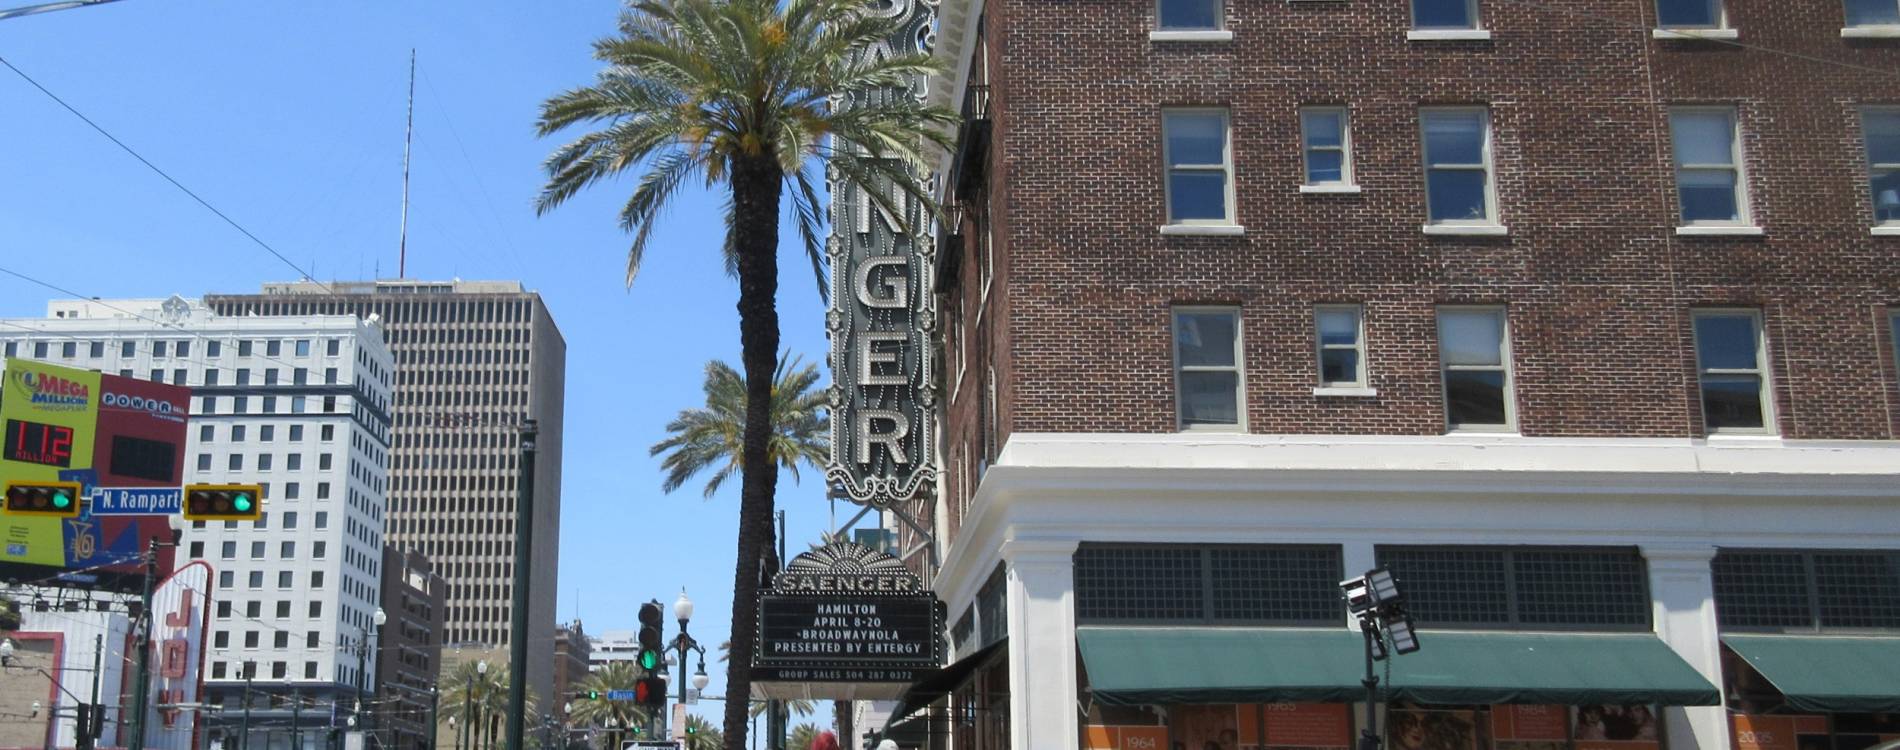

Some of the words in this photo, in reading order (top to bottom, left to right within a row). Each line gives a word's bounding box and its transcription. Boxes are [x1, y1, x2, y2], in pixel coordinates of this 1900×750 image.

[37, 372, 89, 397] MEGA
[103, 490, 115, 508] N.
[120, 490, 179, 512] Rampart
[782, 576, 912, 591] SAENGER
[817, 604, 877, 615] HAMILTON
[813, 617, 849, 627] APRIL
[854, 617, 882, 628] 8-20
[774, 643, 841, 653] PRESENTED
[846, 643, 862, 653] BY
[868, 643, 921, 653] ENTERGY
[778, 671, 809, 679] GROUP
[813, 671, 841, 679] SALES
[845, 671, 864, 679] 504
[612, 690, 633, 700] Basin
[1127, 736, 1156, 748] 1964
